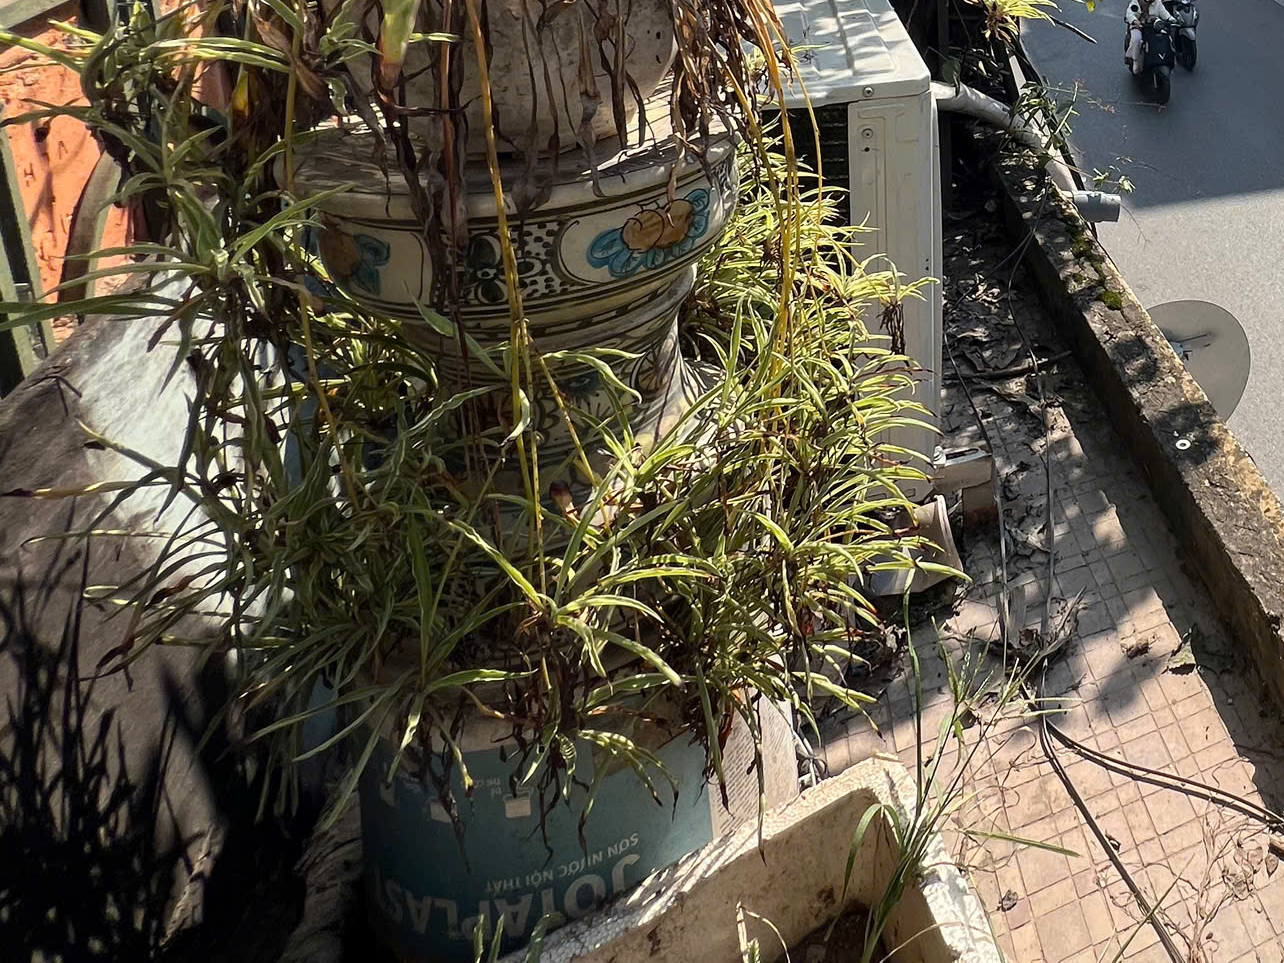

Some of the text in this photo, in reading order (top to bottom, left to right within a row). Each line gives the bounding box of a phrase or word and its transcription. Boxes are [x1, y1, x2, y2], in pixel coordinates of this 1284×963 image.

[606, 833, 640, 859] SƠN
[557, 850, 604, 879] NƯỚC
[525, 868, 554, 888] NỘI
